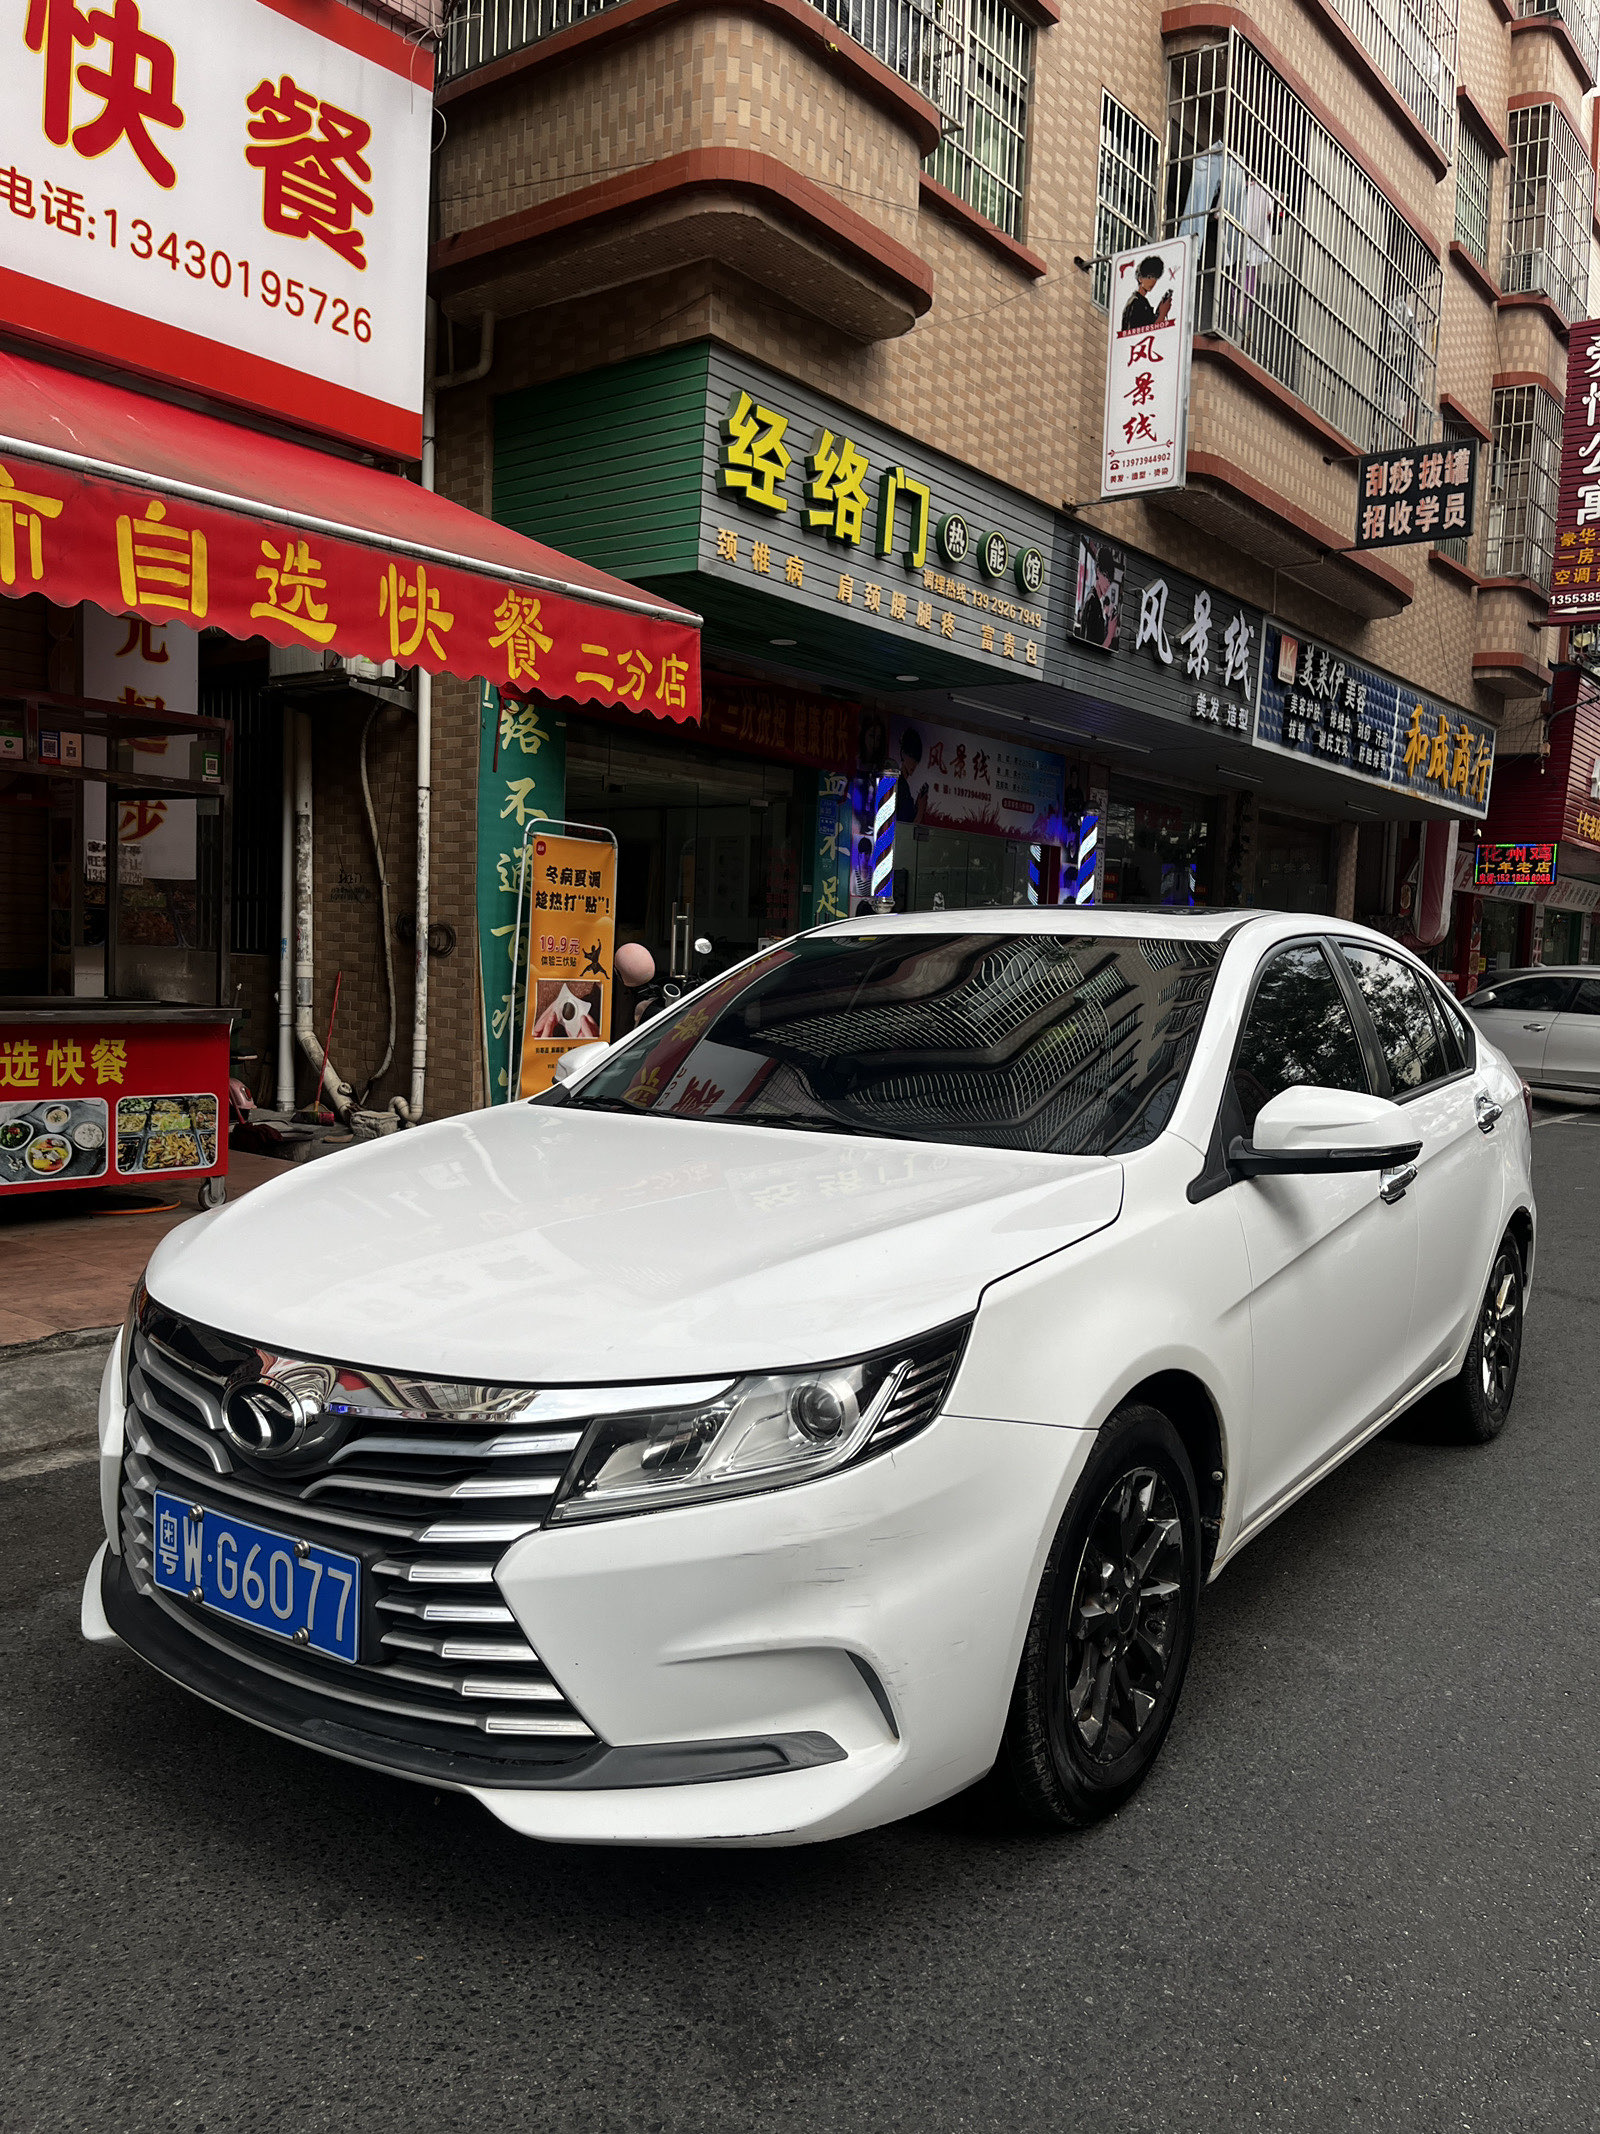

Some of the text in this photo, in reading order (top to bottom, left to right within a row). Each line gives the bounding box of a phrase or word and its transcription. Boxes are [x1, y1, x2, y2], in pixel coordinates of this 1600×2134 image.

[24, 0, 374, 271] 快餐
[0, 167, 373, 343] 电话:13430195726
[1122, 320, 1170, 337] BARBERSHOP
[1123, 336, 1164, 444] 风景线
[1122, 453, 1171, 467] 13973944902
[1366, 448, 1470, 497] 刮痧 拔罐
[716, 390, 1042, 589] 经络门 热能馆
[1362, 492, 1466, 540] 招收学员
[1559, 526, 1600, 548] 豪华
[1553, 566, 1600, 586] 空调
[1558, 547, 1600, 565] 一房
[716, 527, 1038, 666] 颈椎病 肩颈腰腿疼 富贵包
[1136, 578, 1255, 701] 风景线
[576, 642, 689, 708] 二分店
[1195, 692, 1249, 731] 美发 造型
[927, 741, 991, 786] 风景线
[545, 864, 601, 889] 冬病夏调
[1479, 861, 1552, 874] 十年老店
[539, 934, 580, 955] 19.9元
[540, 955, 577, 966] 体验三伏贴
[158, 1510, 353, 1642] 粤W·G6077
